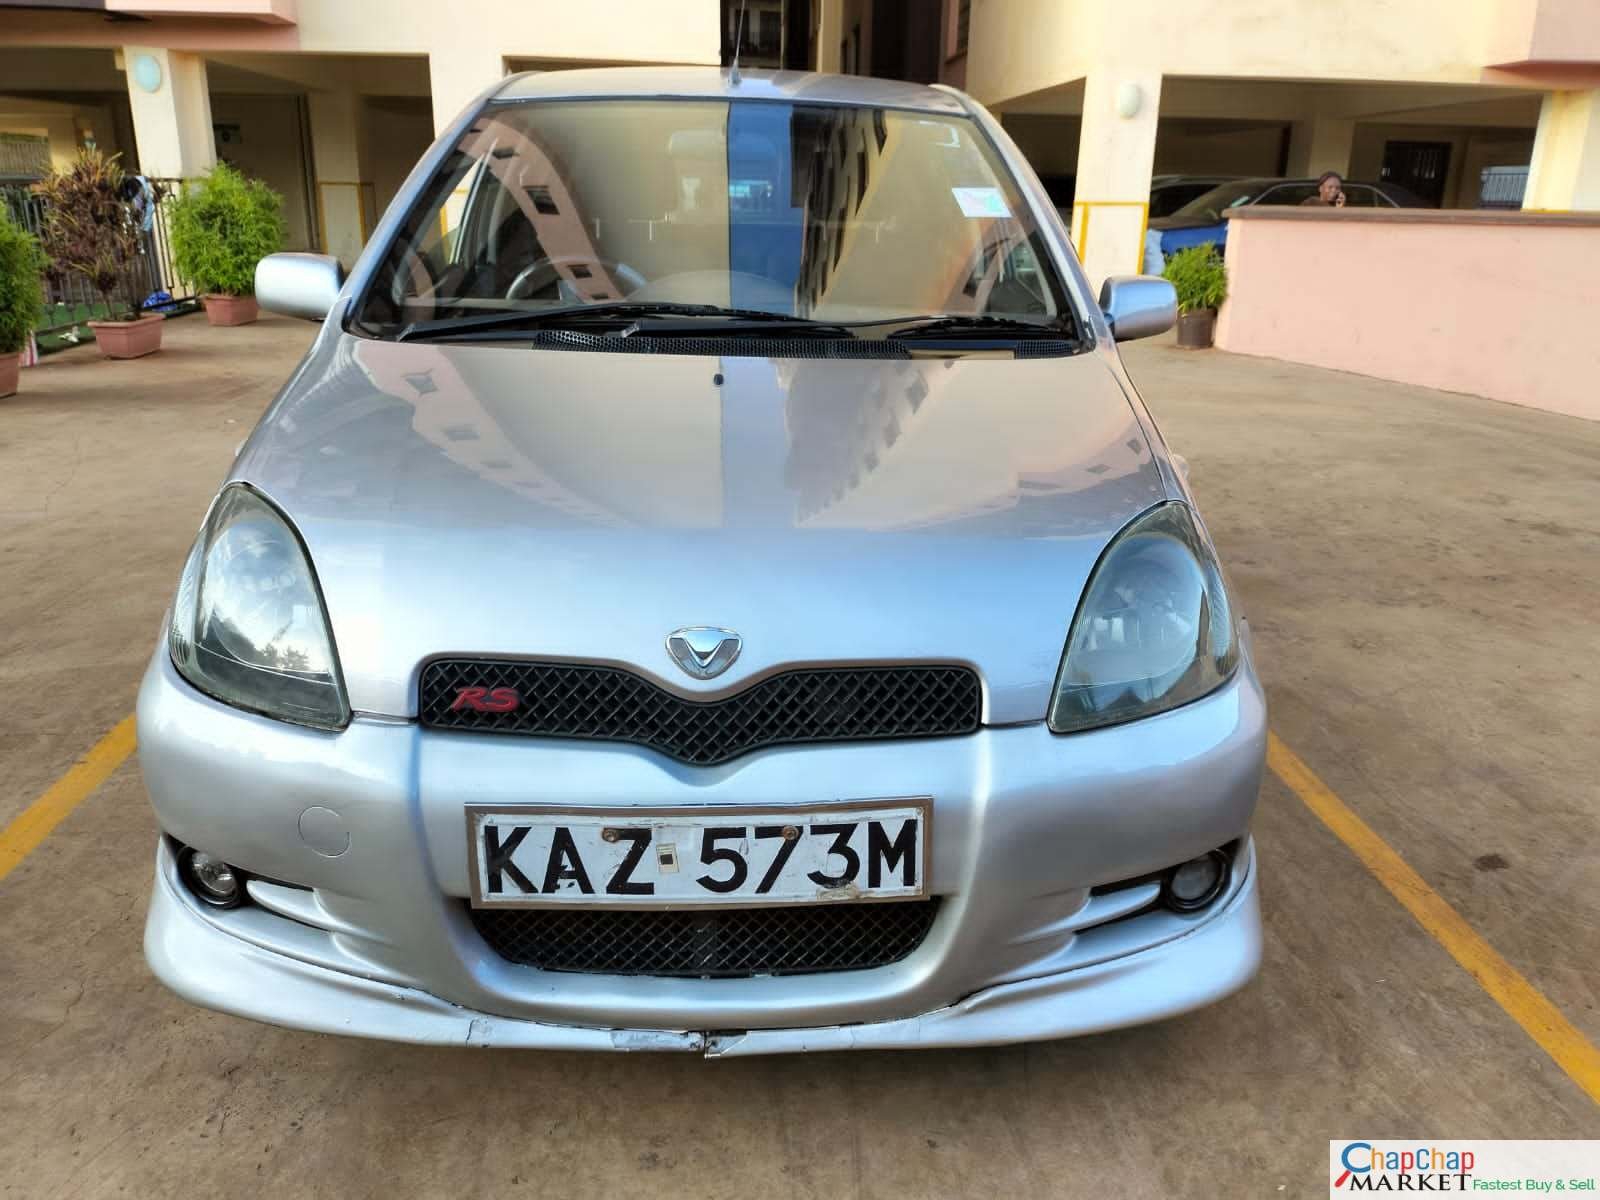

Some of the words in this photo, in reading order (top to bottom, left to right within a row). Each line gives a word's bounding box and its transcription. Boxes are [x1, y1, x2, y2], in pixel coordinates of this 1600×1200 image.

[451, 686, 520, 713] RS
[483, 825, 655, 896] KAZ
[695, 819, 918, 895] 573M
